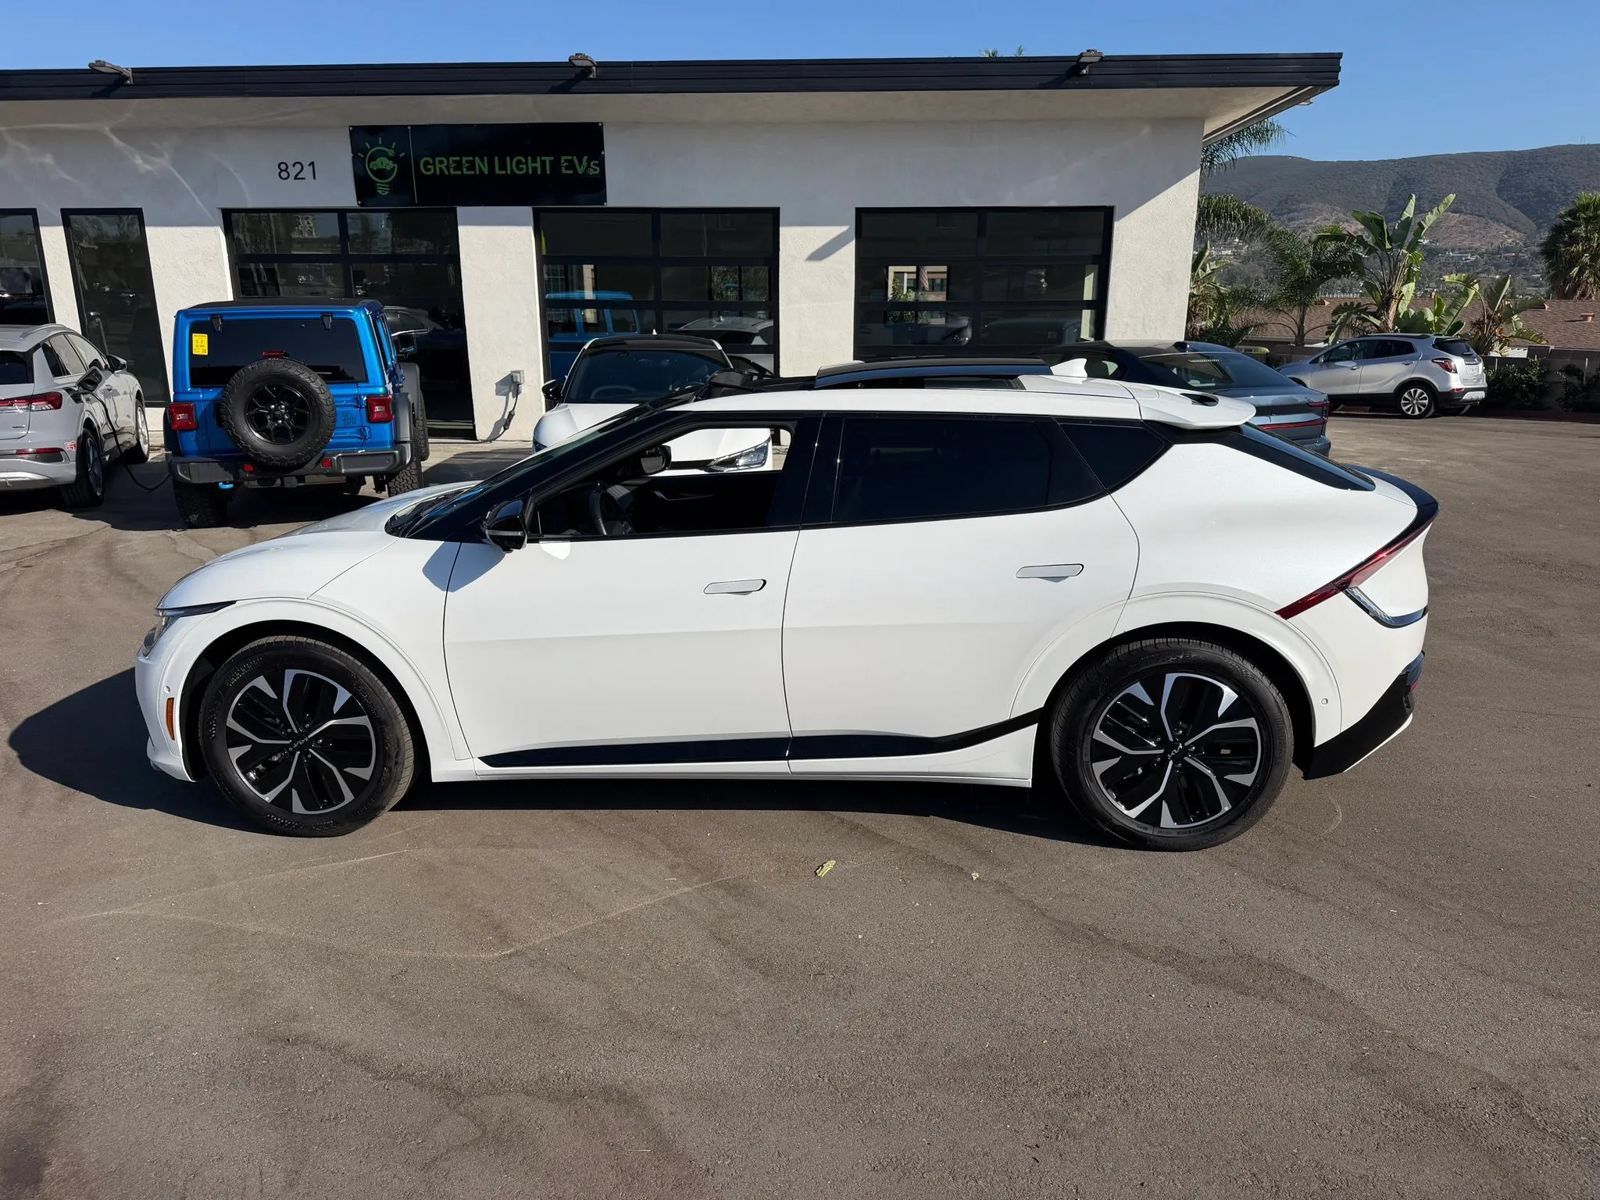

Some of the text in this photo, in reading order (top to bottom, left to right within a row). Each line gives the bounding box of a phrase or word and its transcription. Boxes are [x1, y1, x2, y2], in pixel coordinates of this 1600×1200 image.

[277, 160, 316, 180] 821
[419, 156, 488, 175] GREEN
[495, 155, 554, 175] LIGHT
